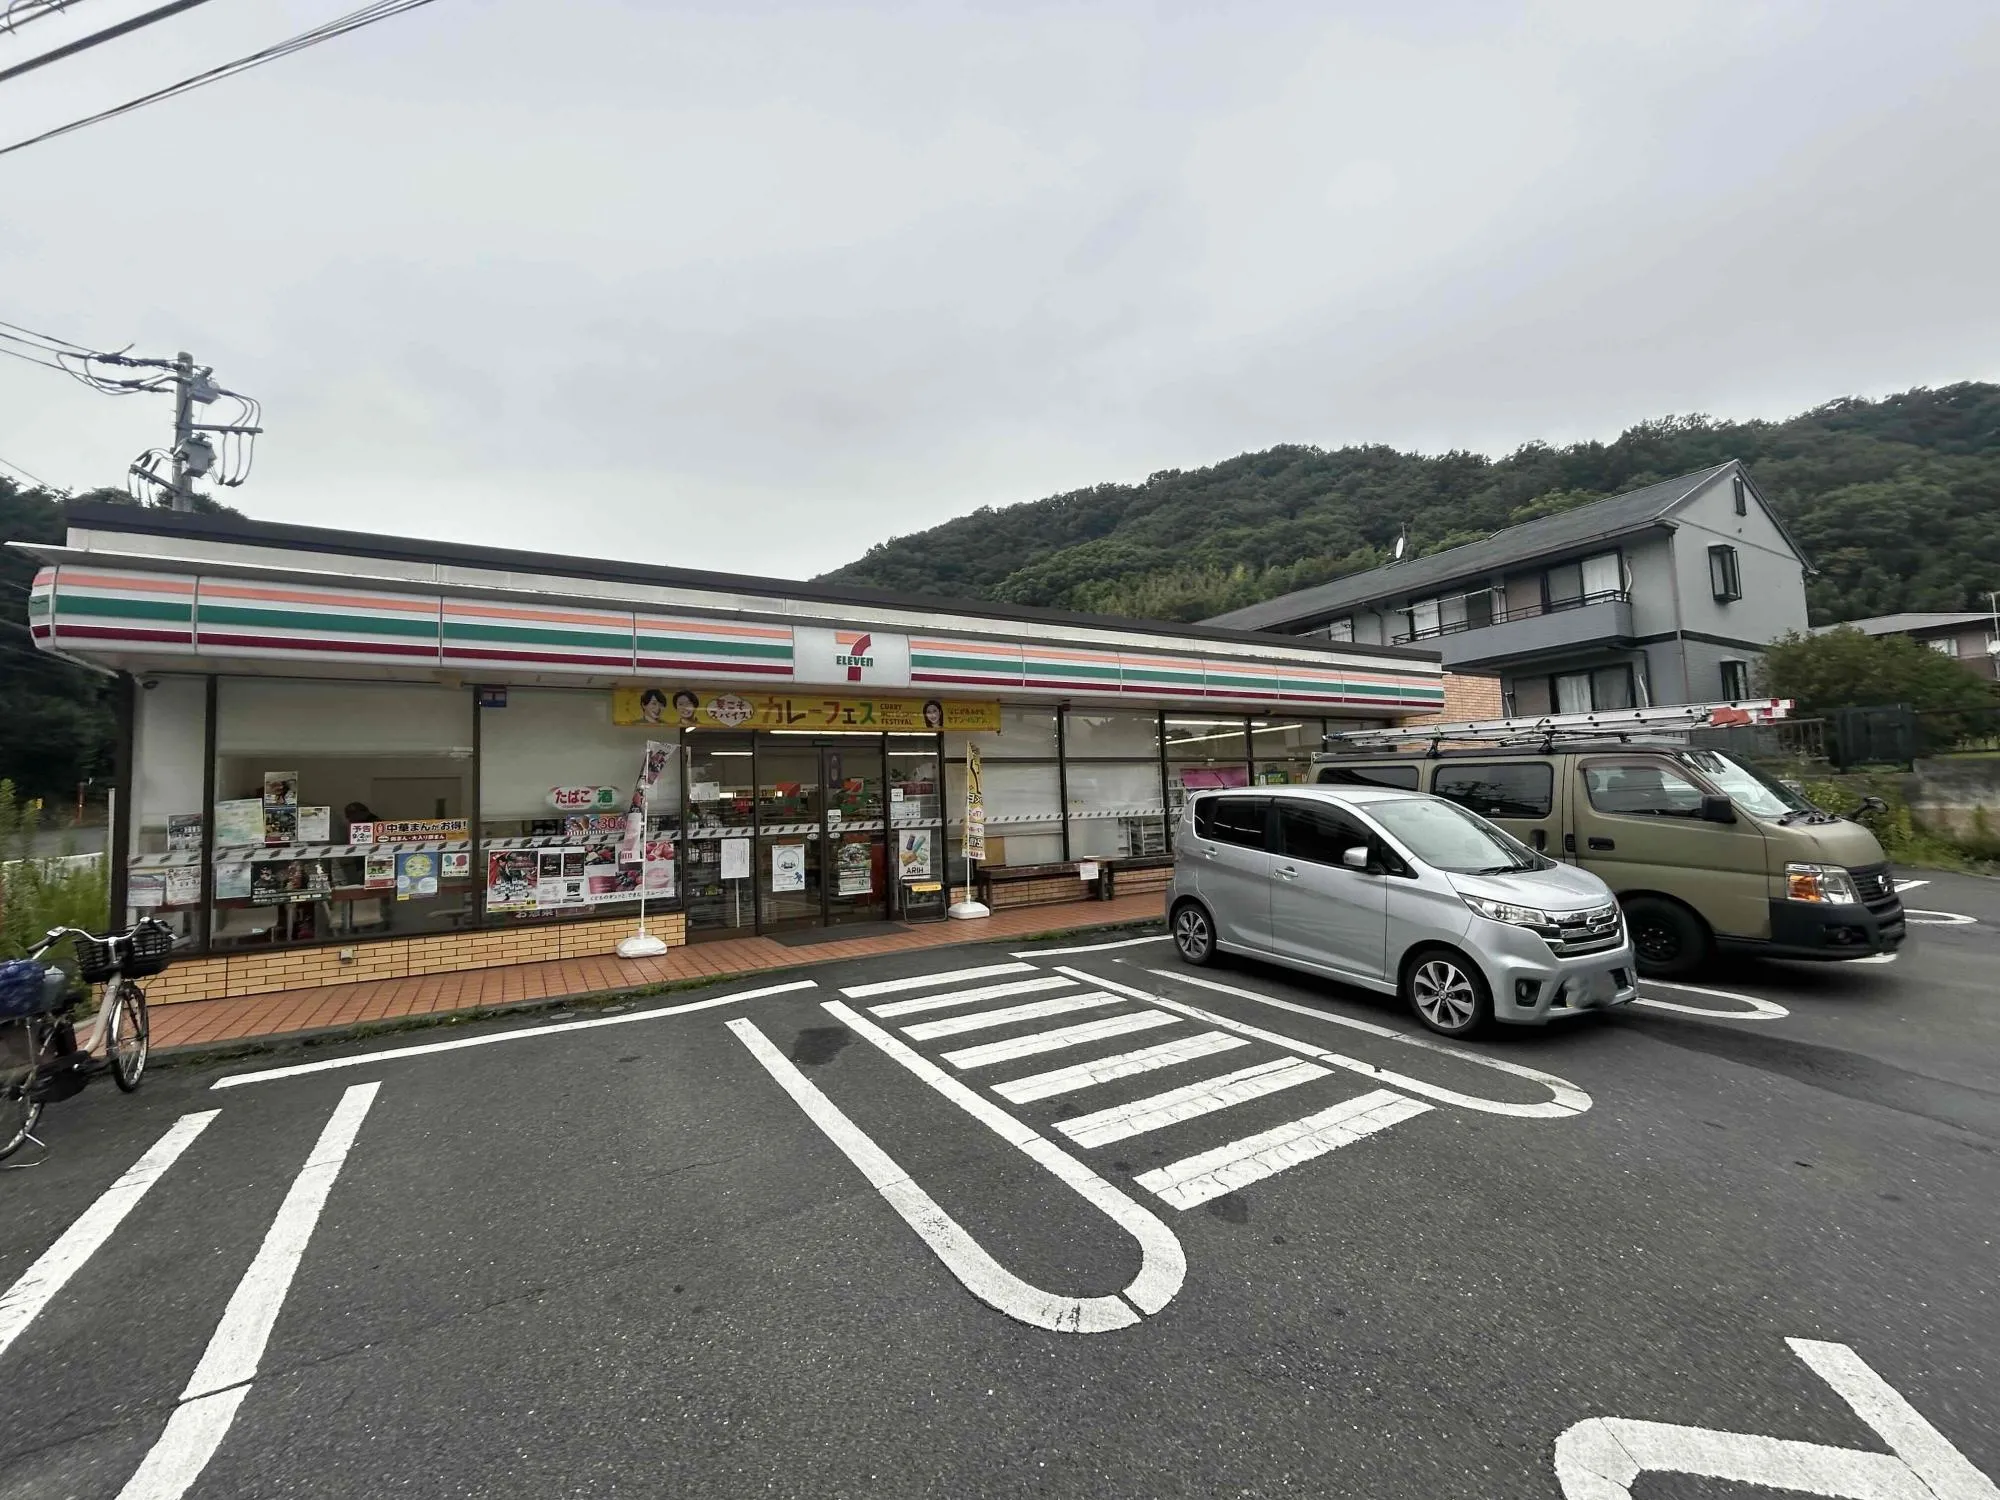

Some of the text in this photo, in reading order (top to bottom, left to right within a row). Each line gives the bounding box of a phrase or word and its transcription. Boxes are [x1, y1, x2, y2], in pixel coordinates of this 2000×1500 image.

[758, 696, 877, 724] カレーフェス
[880, 703, 902, 712] CURRY
[881, 718, 912, 726] FESTIVAL
[555, 789, 613, 804] たばこ 酒
[352, 825, 371, 833] 予告
[386, 820, 467, 833] 中華まんがお得!
